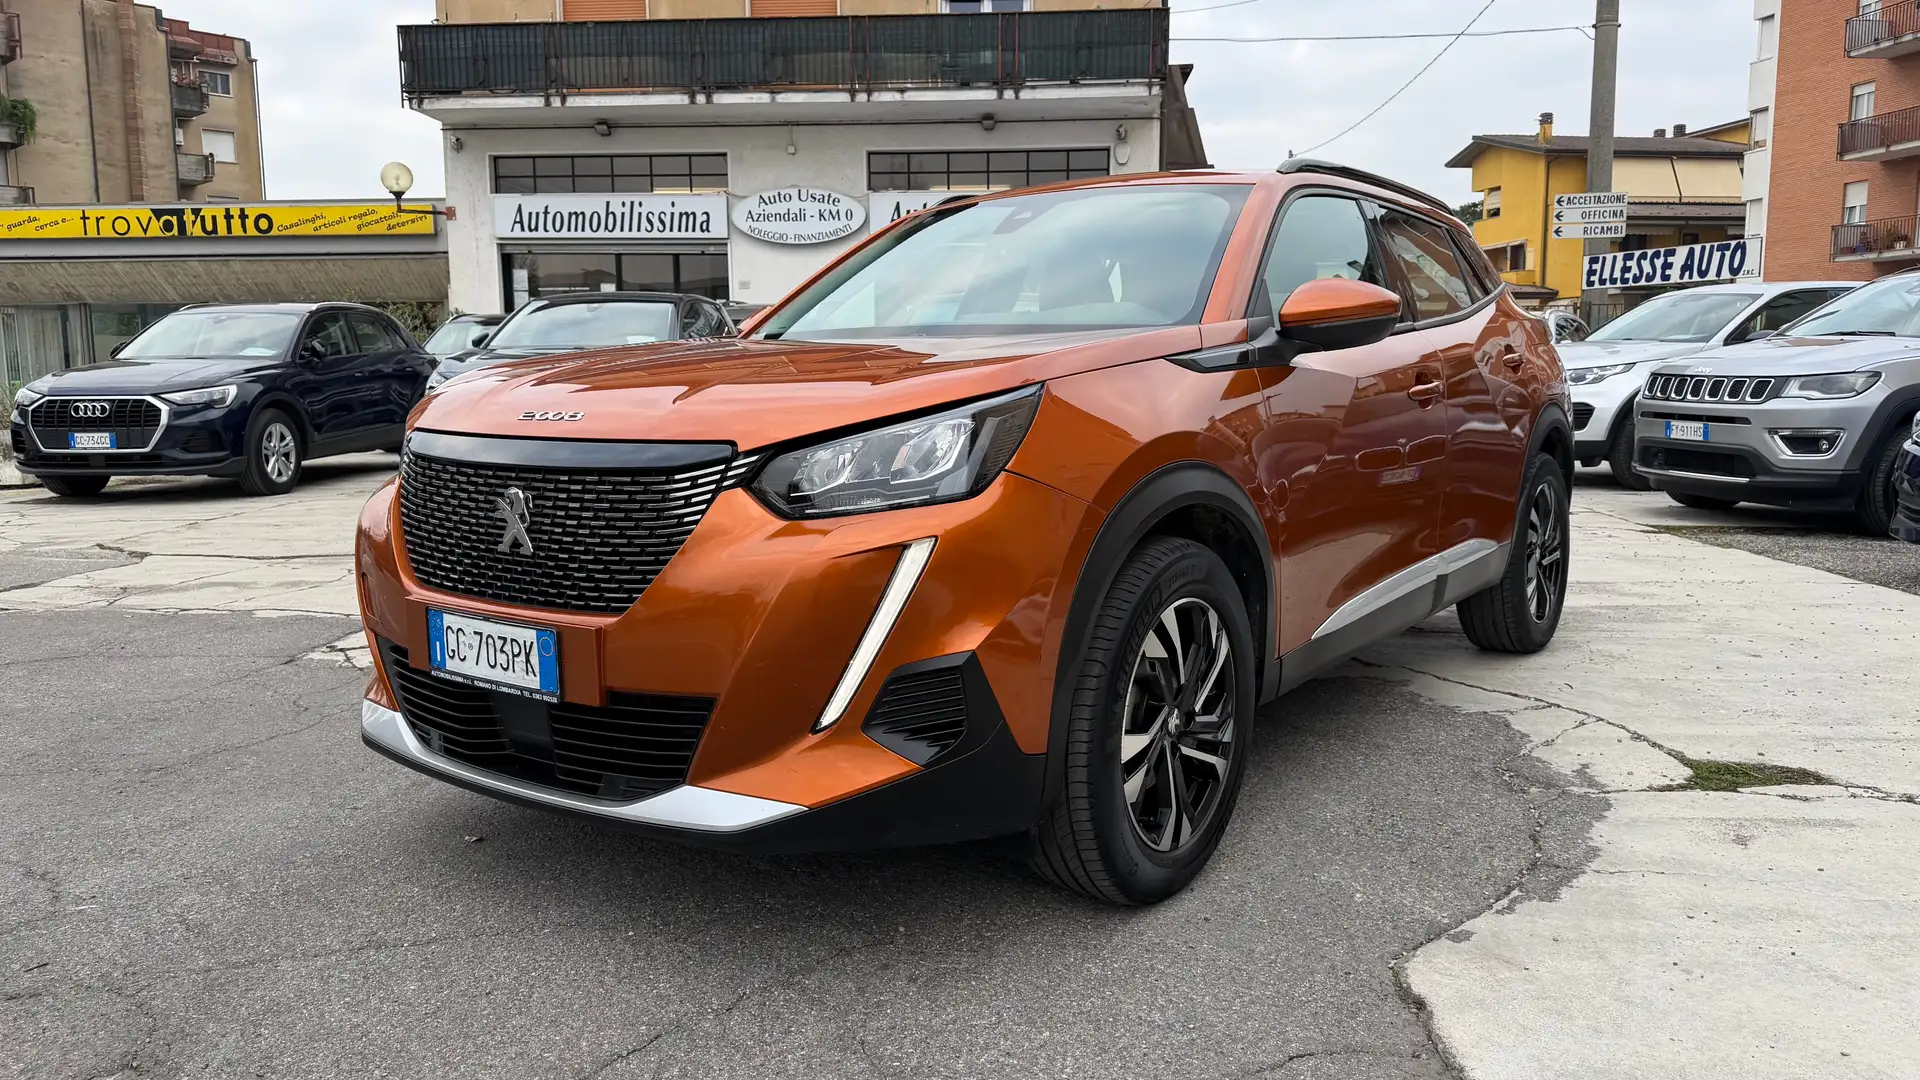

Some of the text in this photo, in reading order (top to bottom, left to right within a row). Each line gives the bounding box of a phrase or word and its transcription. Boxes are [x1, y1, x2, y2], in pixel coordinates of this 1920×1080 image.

[757, 189, 841, 208] Auto Usate
[1566, 194, 1627, 206] ACCETTAZIONE
[6, 215, 40, 232] guarda,
[79, 207, 274, 236] trovatutto
[276, 212, 327, 232] Casalinghi,
[312, 208, 379, 232] articoli regalo,
[385, 214, 428, 232] detersivi
[510, 200, 712, 233] Automobilissima
[745, 208, 806, 223] Aziendali
[818, 208, 841, 222] KM
[845, 208, 853, 222] 0
[1580, 209, 1625, 220] OFFICINA
[34, 220, 60, 232] cerca
[747, 224, 788, 242] NOLEGGIO
[793, 224, 853, 243] FINANZIAMENTI
[1583, 225, 1623, 236] RICAMBI
[1585, 248, 1677, 288] ELLESSE
[1679, 240, 1747, 281] AUTO
[517, 411, 585, 421] 2008
